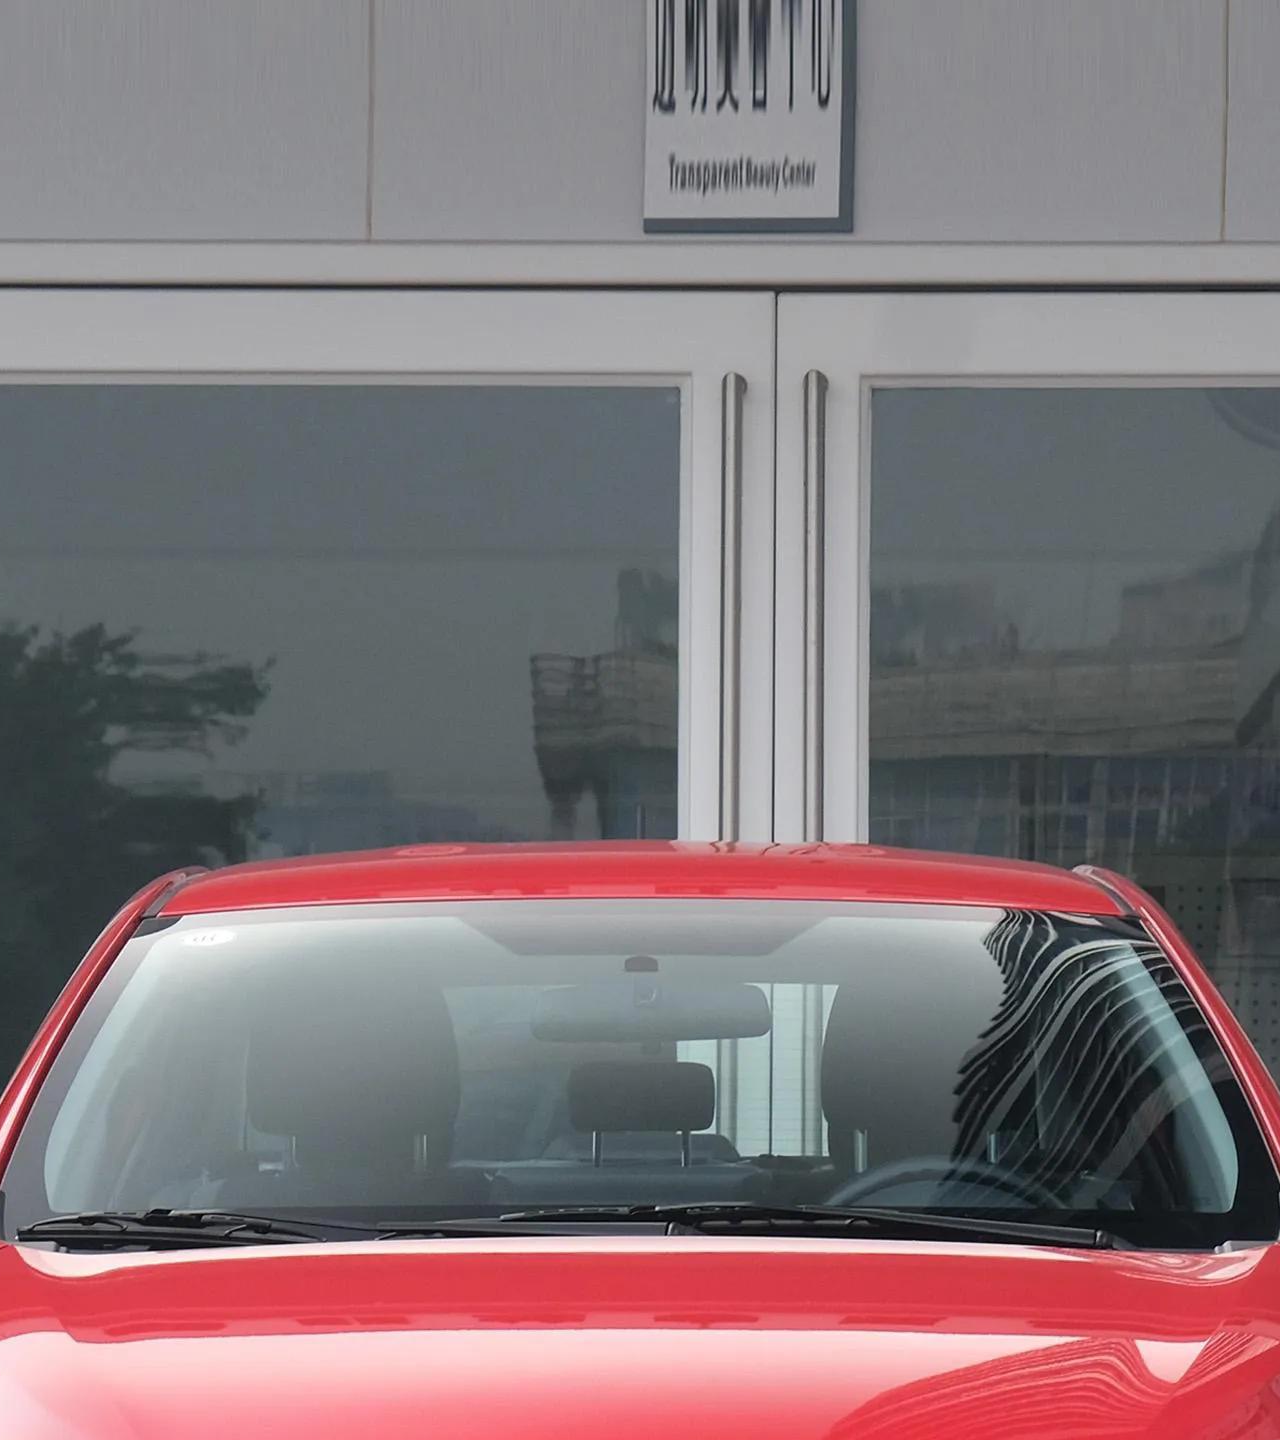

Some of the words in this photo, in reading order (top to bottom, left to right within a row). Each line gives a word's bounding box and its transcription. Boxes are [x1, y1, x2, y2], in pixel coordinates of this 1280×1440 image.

[669, 153, 743, 197] Transparent
[746, 156, 781, 195] Beauty
[782, 155, 816, 190] Center
